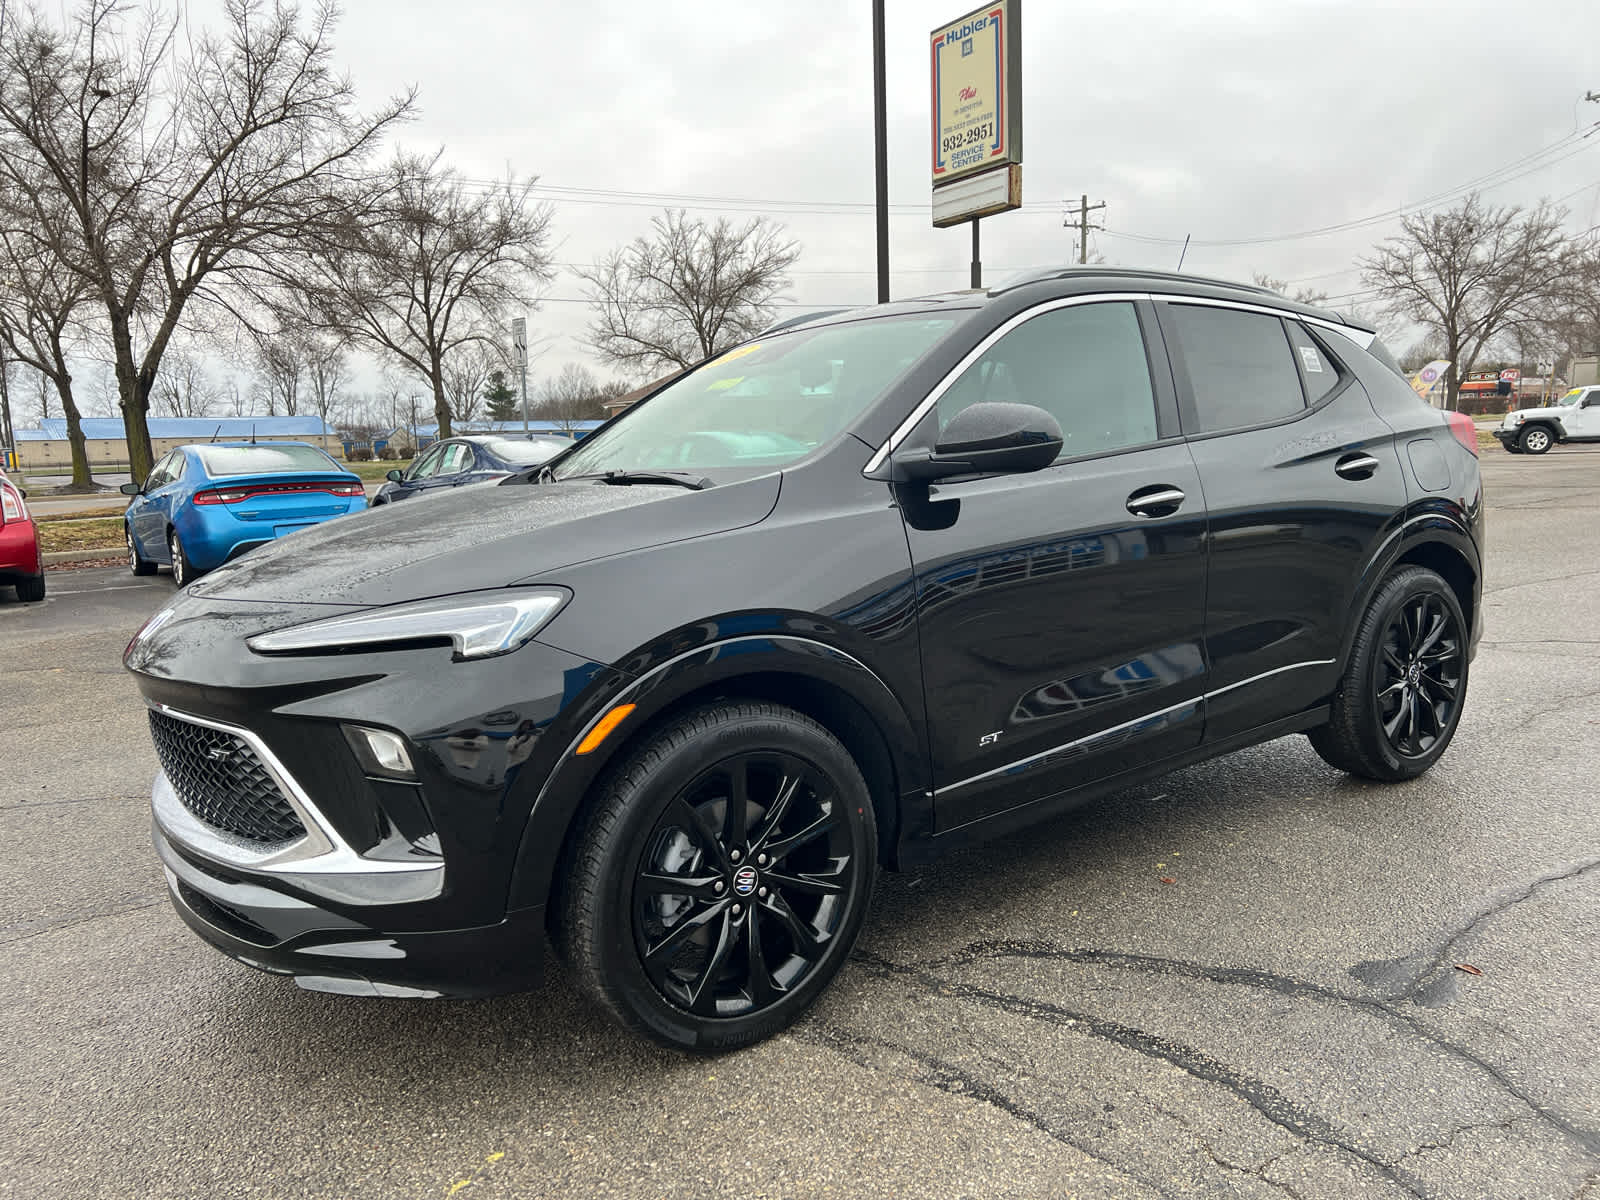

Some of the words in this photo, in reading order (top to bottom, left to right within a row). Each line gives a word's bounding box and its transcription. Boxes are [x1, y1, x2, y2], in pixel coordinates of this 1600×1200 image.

[946, 16, 988, 45] Hubler
[959, 86, 977, 101] Plus
[943, 121, 993, 153] 932-2951
[951, 143, 984, 161] SERVICE
[952, 153, 983, 169] CENTER
[979, 730, 1004, 747] ST
